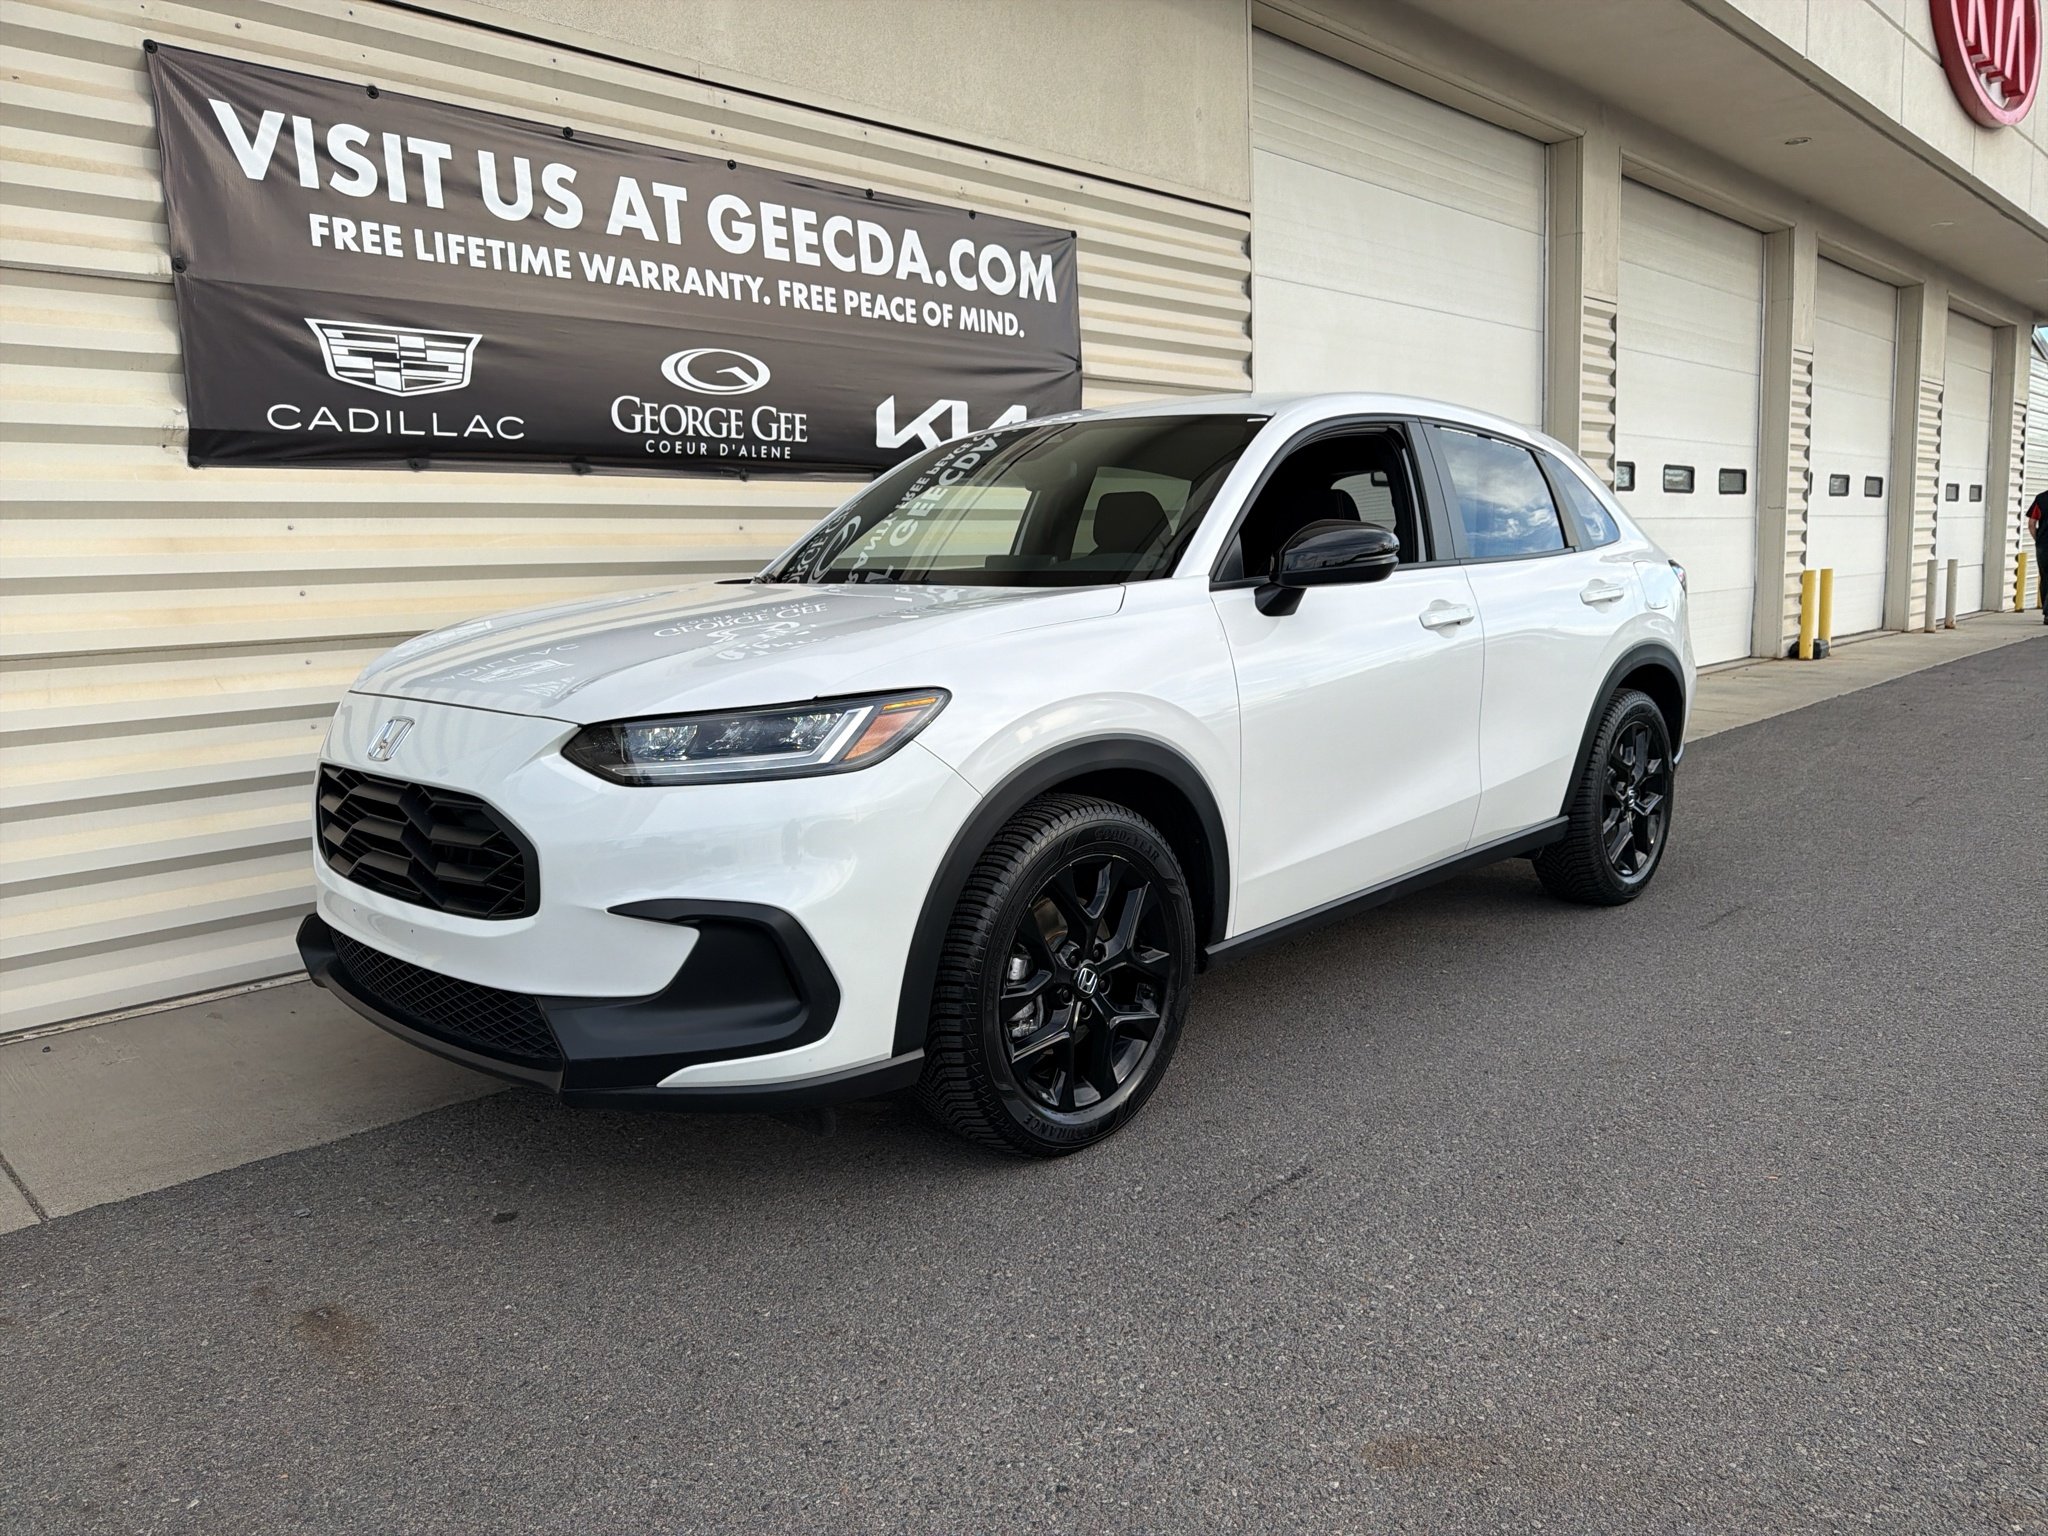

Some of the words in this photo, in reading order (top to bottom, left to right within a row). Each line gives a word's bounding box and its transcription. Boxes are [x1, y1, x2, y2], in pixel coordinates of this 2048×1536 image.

[208, 98, 453, 209] VISIT
[477, 150, 584, 230] US
[605, 176, 688, 245] AT
[706, 194, 1057, 303] GEECDA.COM
[309, 213, 404, 258] FREE
[413, 228, 573, 280] LIFETIME
[578, 251, 771, 305] WARRANTY.
[778, 279, 838, 314] FREE
[844, 289, 917, 324] PEACE
[922, 300, 953, 329] OF
[958, 308, 1026, 338] MIND.
[266, 403, 525, 440] CADILLAC
[610, 395, 745, 440] GEORGE
[751, 405, 808, 443] GEE
[645, 439, 708, 457] COEUR
[719, 441, 792, 460] D'ALENE
